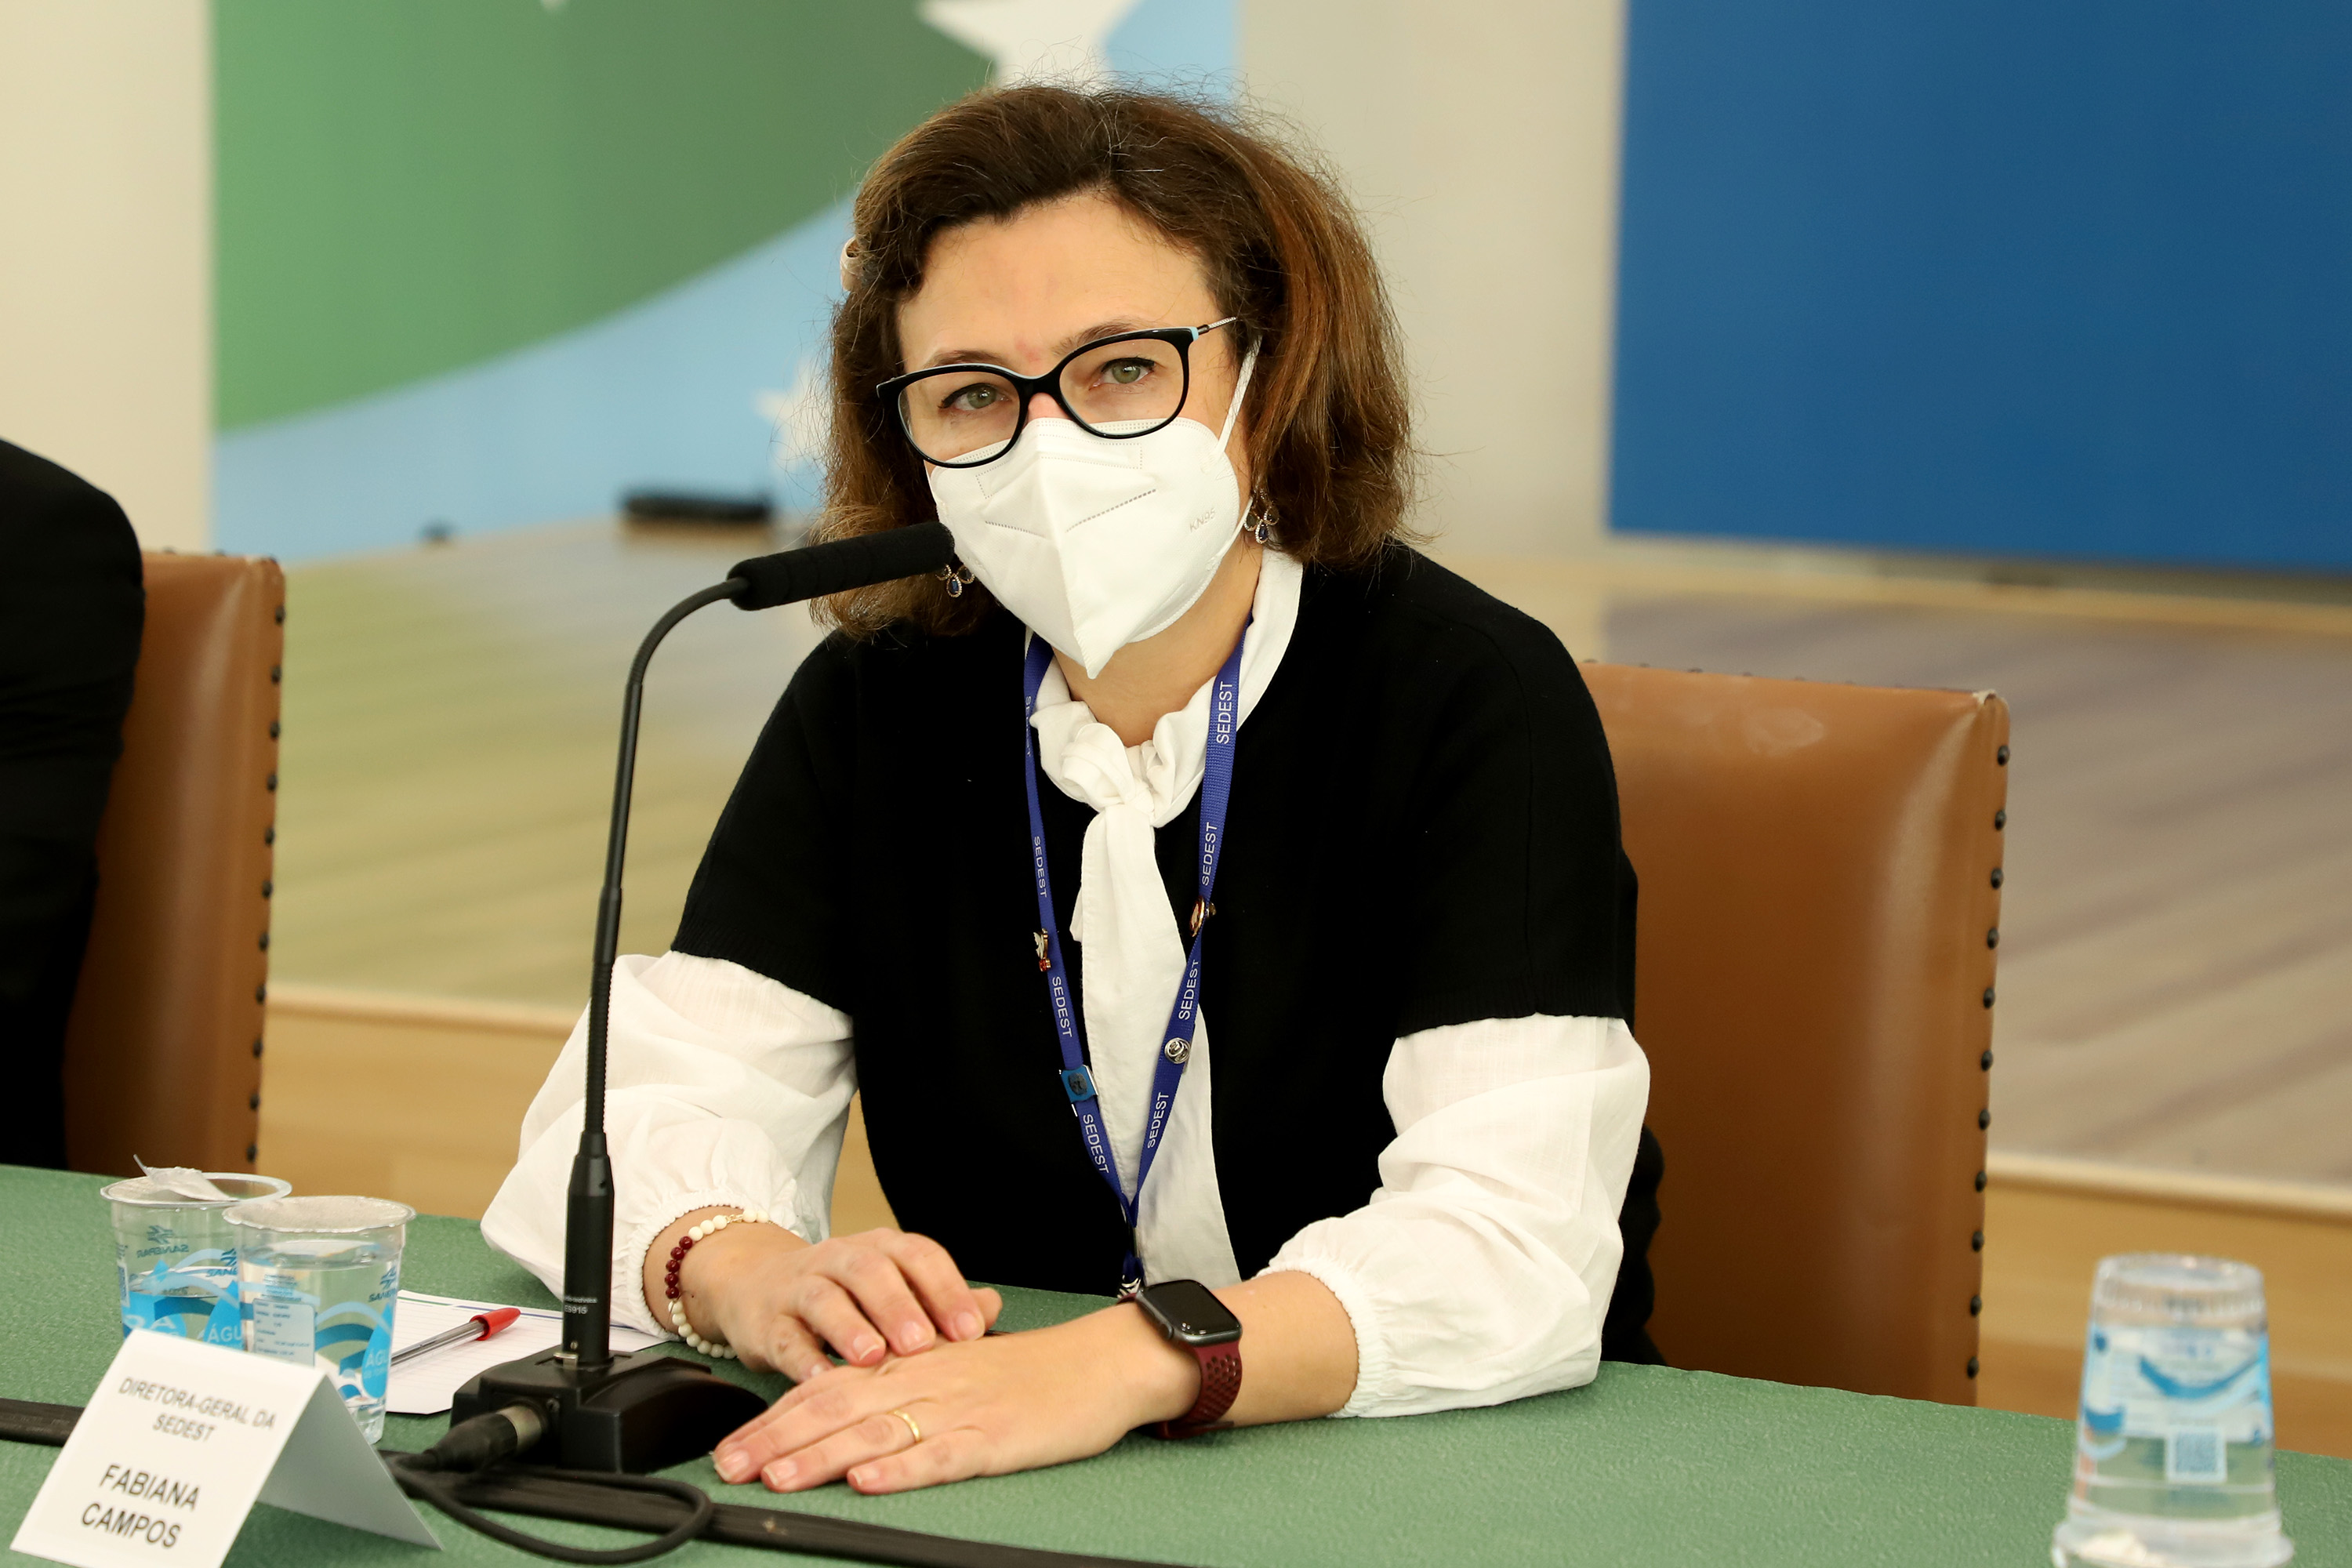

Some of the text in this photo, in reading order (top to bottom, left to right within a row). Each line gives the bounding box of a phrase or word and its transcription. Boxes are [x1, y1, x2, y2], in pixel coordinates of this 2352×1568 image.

[1189, 507, 1215, 533] KN95
[1216, 681, 1233, 744] SEDEST
[1033, 836, 1047, 898] SEDEST
[1201, 822, 1218, 887] SEDEST
[1052, 976, 1073, 1038] SEDEST
[1178, 959, 1200, 1020] SEDEST
[1083, 1113, 1109, 1174] SEDEST
[1146, 1091, 1170, 1149] SEDEST
[205, 1268, 238, 1278] SANE
[208, 1323, 244, 1344] ÁGU
[118, 1377, 277, 1429] DIRETORA-GERAL DA
[152, 1414, 216, 1442] SEDEST
[99, 1465, 200, 1512] FABIANA
[81, 1502, 181, 1548] CAMPOS
